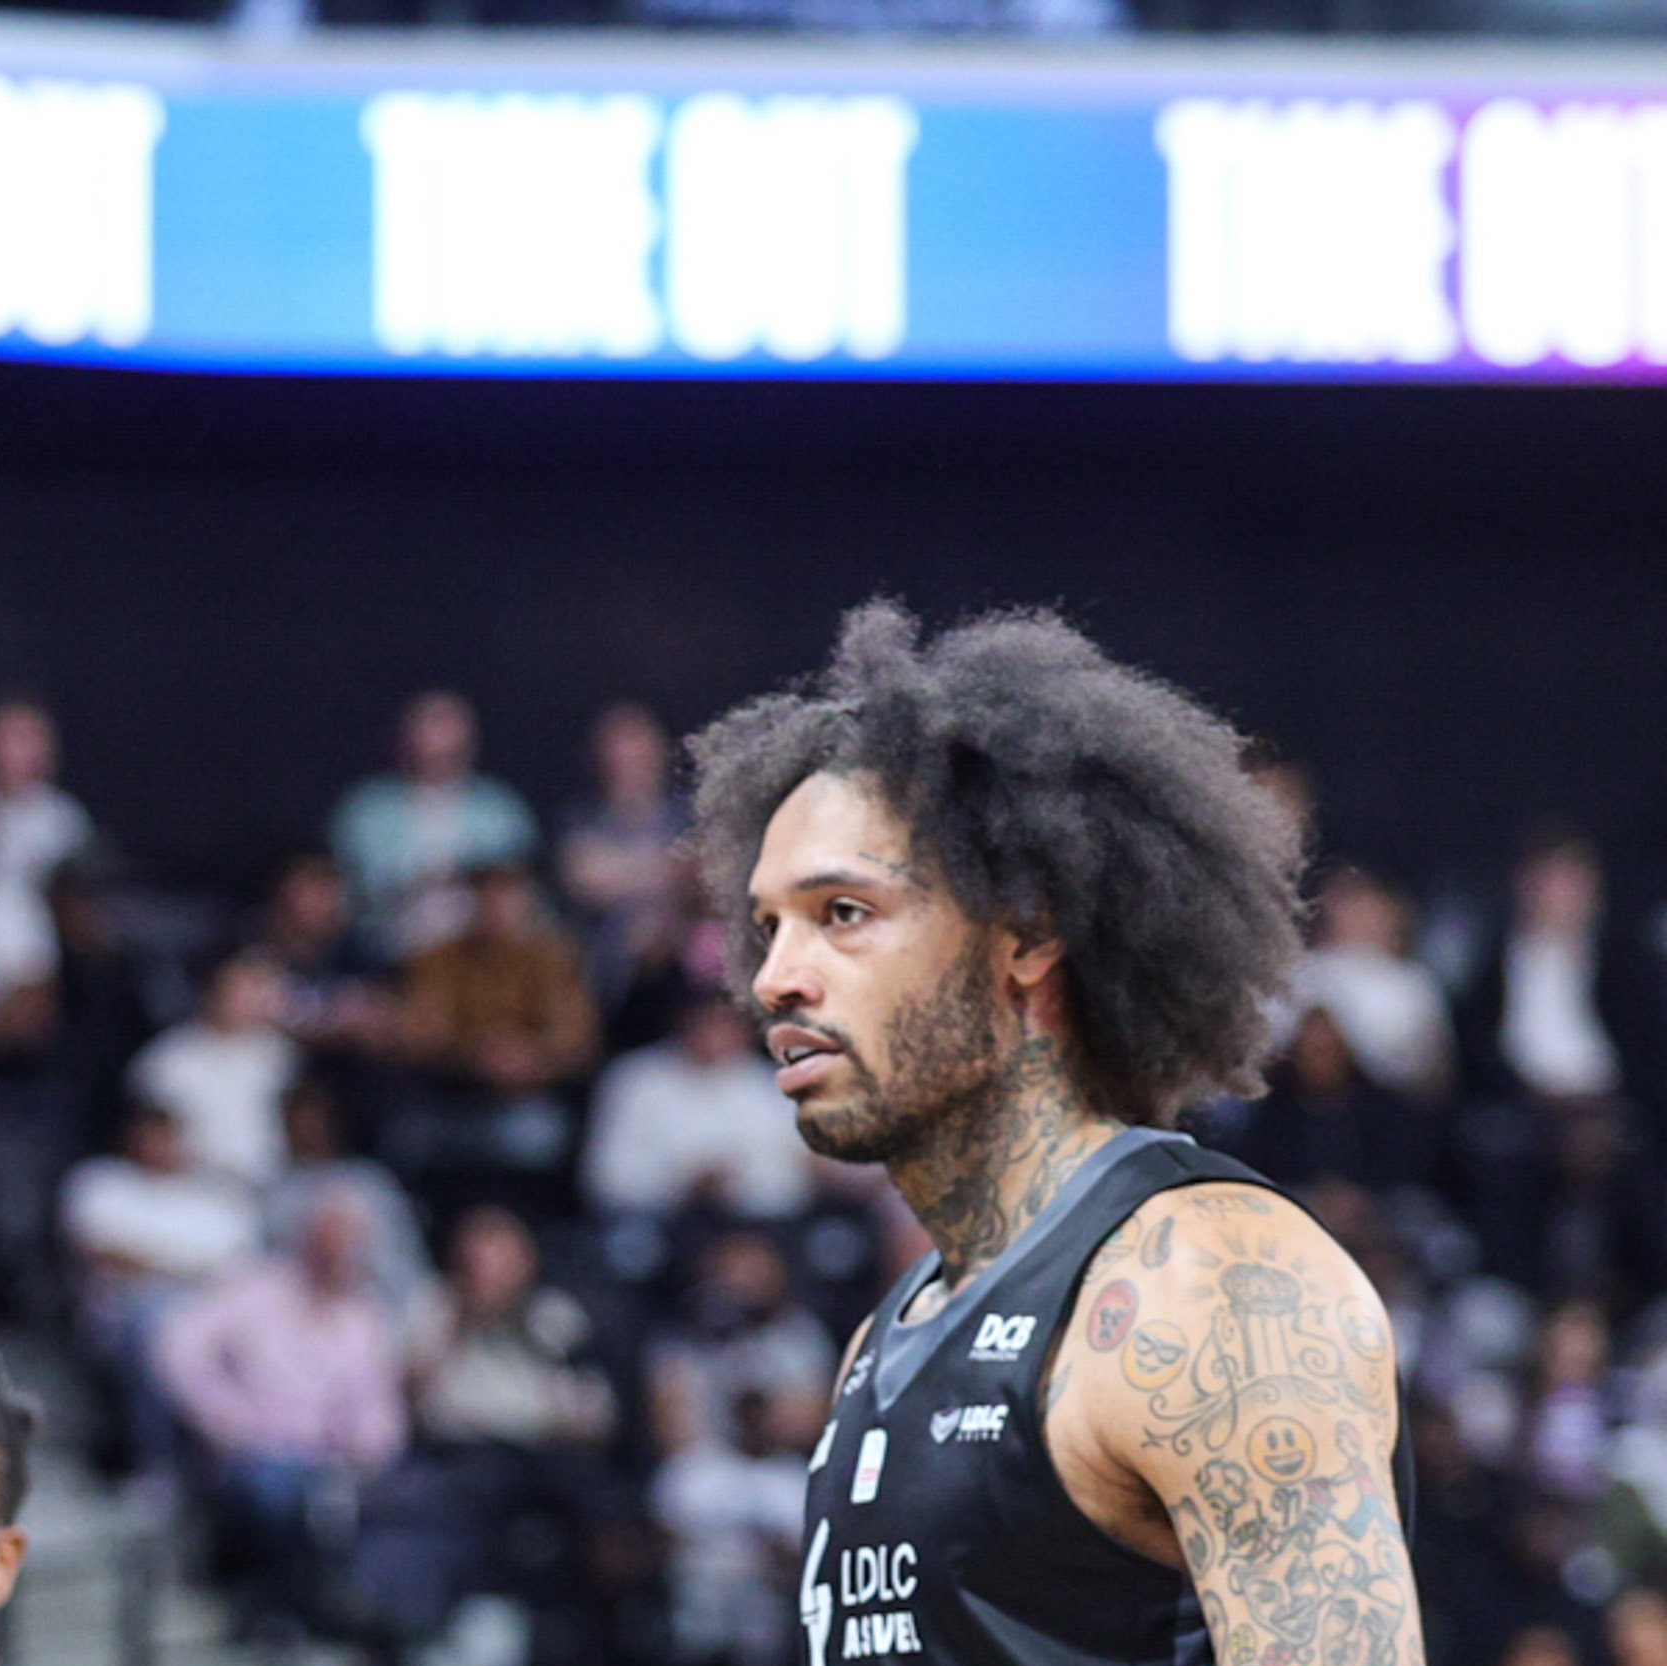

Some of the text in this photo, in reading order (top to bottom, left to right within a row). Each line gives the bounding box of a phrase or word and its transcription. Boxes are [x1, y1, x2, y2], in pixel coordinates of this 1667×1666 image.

[974, 1314, 1036, 1350] DCB
[842, 1543, 916, 1605] LDLC
[843, 1613, 921, 1658] ASVEL
